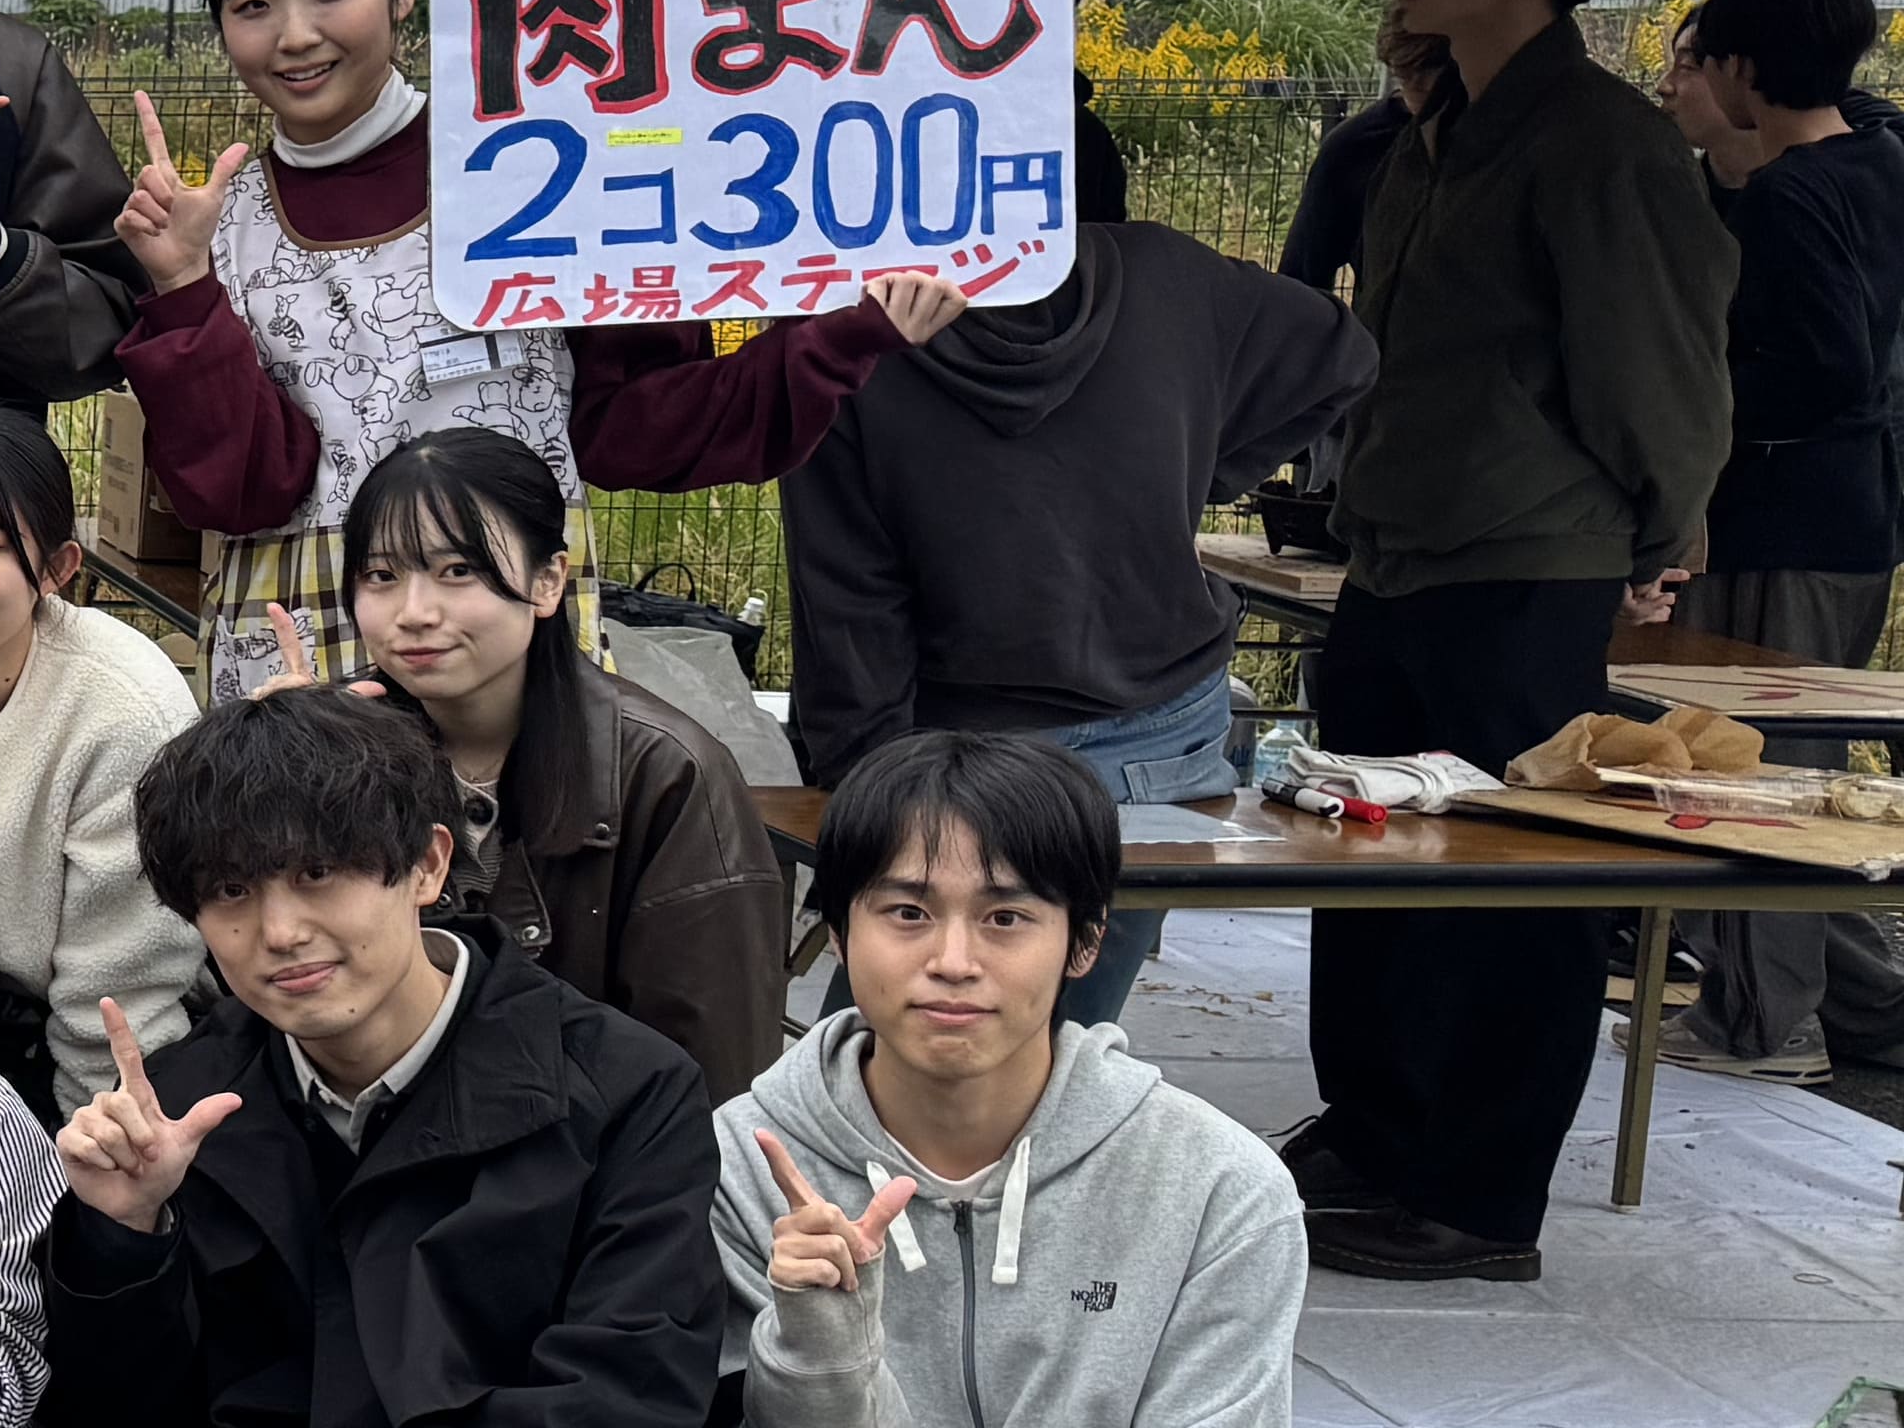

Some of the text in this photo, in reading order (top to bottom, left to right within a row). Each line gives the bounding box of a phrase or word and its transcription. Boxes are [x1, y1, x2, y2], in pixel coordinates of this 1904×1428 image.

[473, 237, 1045, 328] 広場ステージ
